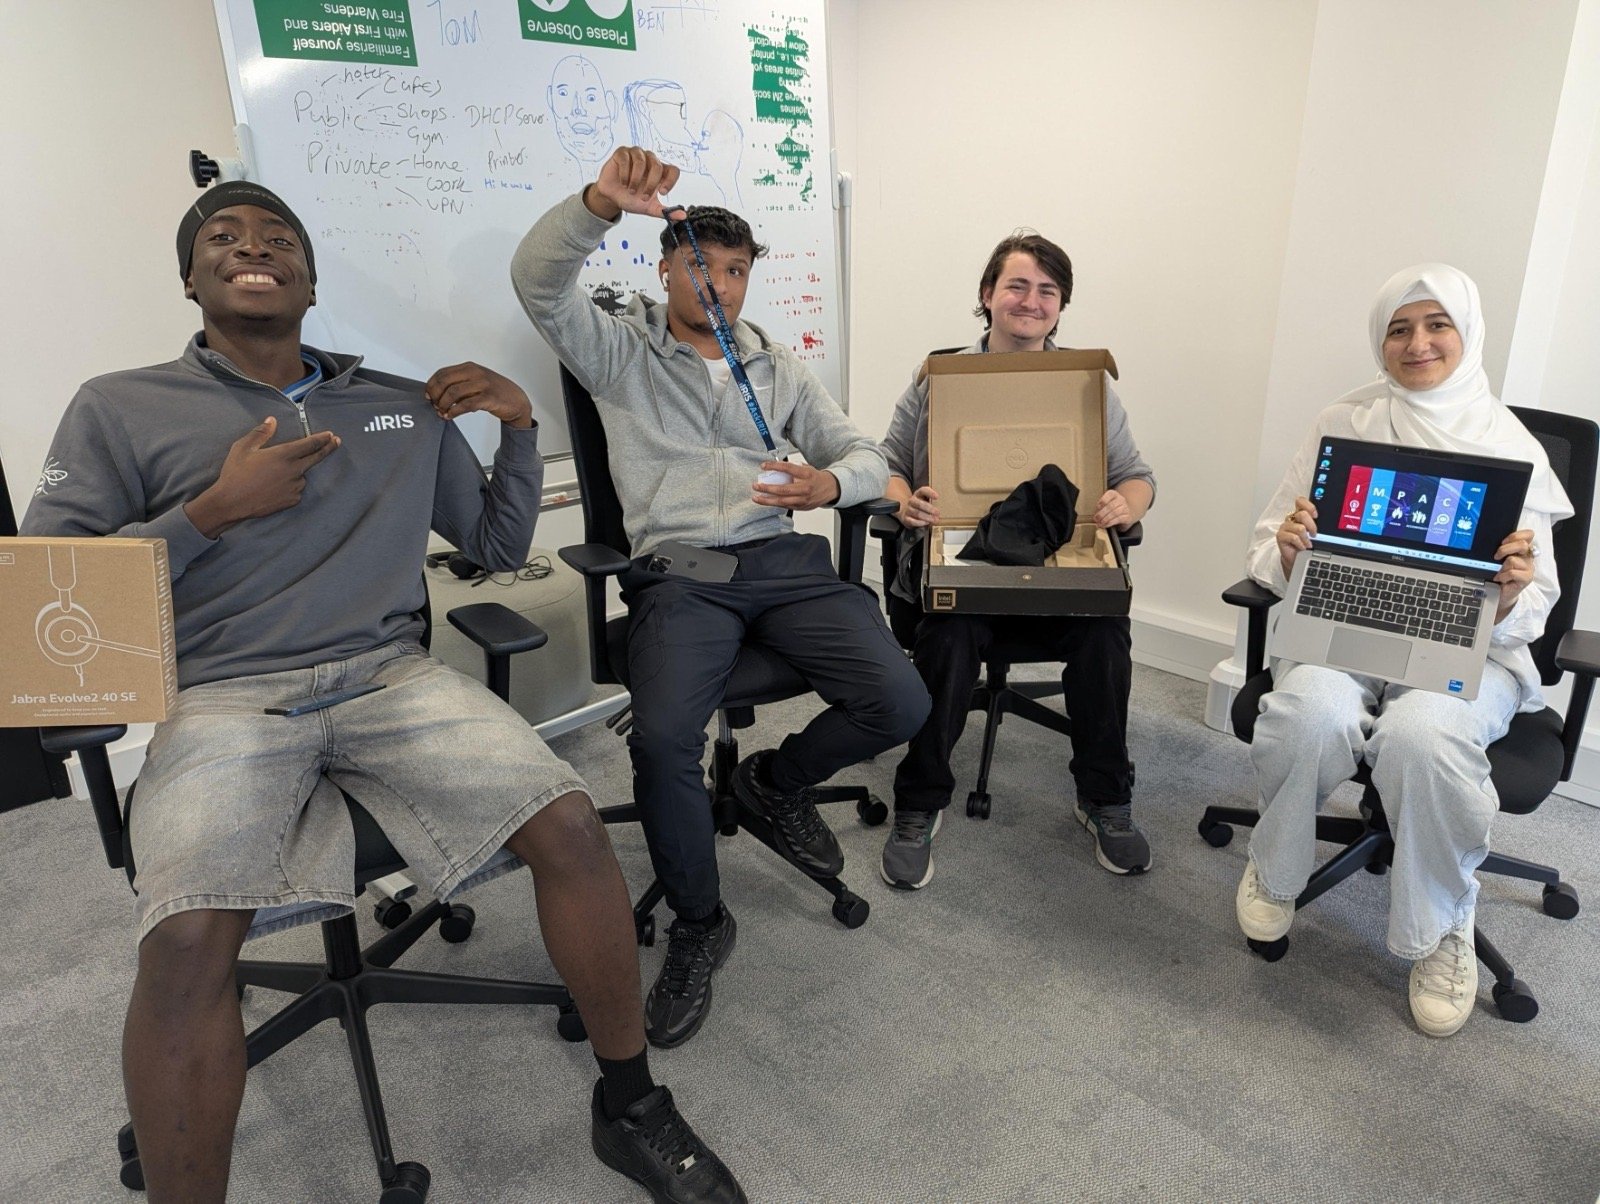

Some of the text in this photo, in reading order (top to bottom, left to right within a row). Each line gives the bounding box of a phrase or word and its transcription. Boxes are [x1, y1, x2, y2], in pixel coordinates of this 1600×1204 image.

[320, 3, 405, 23] Fire Wardens.
[637, 9, 665, 35] BEN
[284, 18, 408, 39] with First Aiders and
[527, 19, 628, 46] Please Observe
[293, 37, 411, 58] Familiarise yourself
[753, 62, 763, 72] yo
[785, 67, 809, 78] anitise
[753, 90, 771, 100] socia
[294, 90, 367, 131] Public
[465, 104, 514, 128] DHCP
[308, 141, 391, 179] Private
[739, 382, 753, 402] IRIS
[364, 414, 415, 432] IRIS
[11, 691, 137, 705] Jabra Evolve2 40 SE
